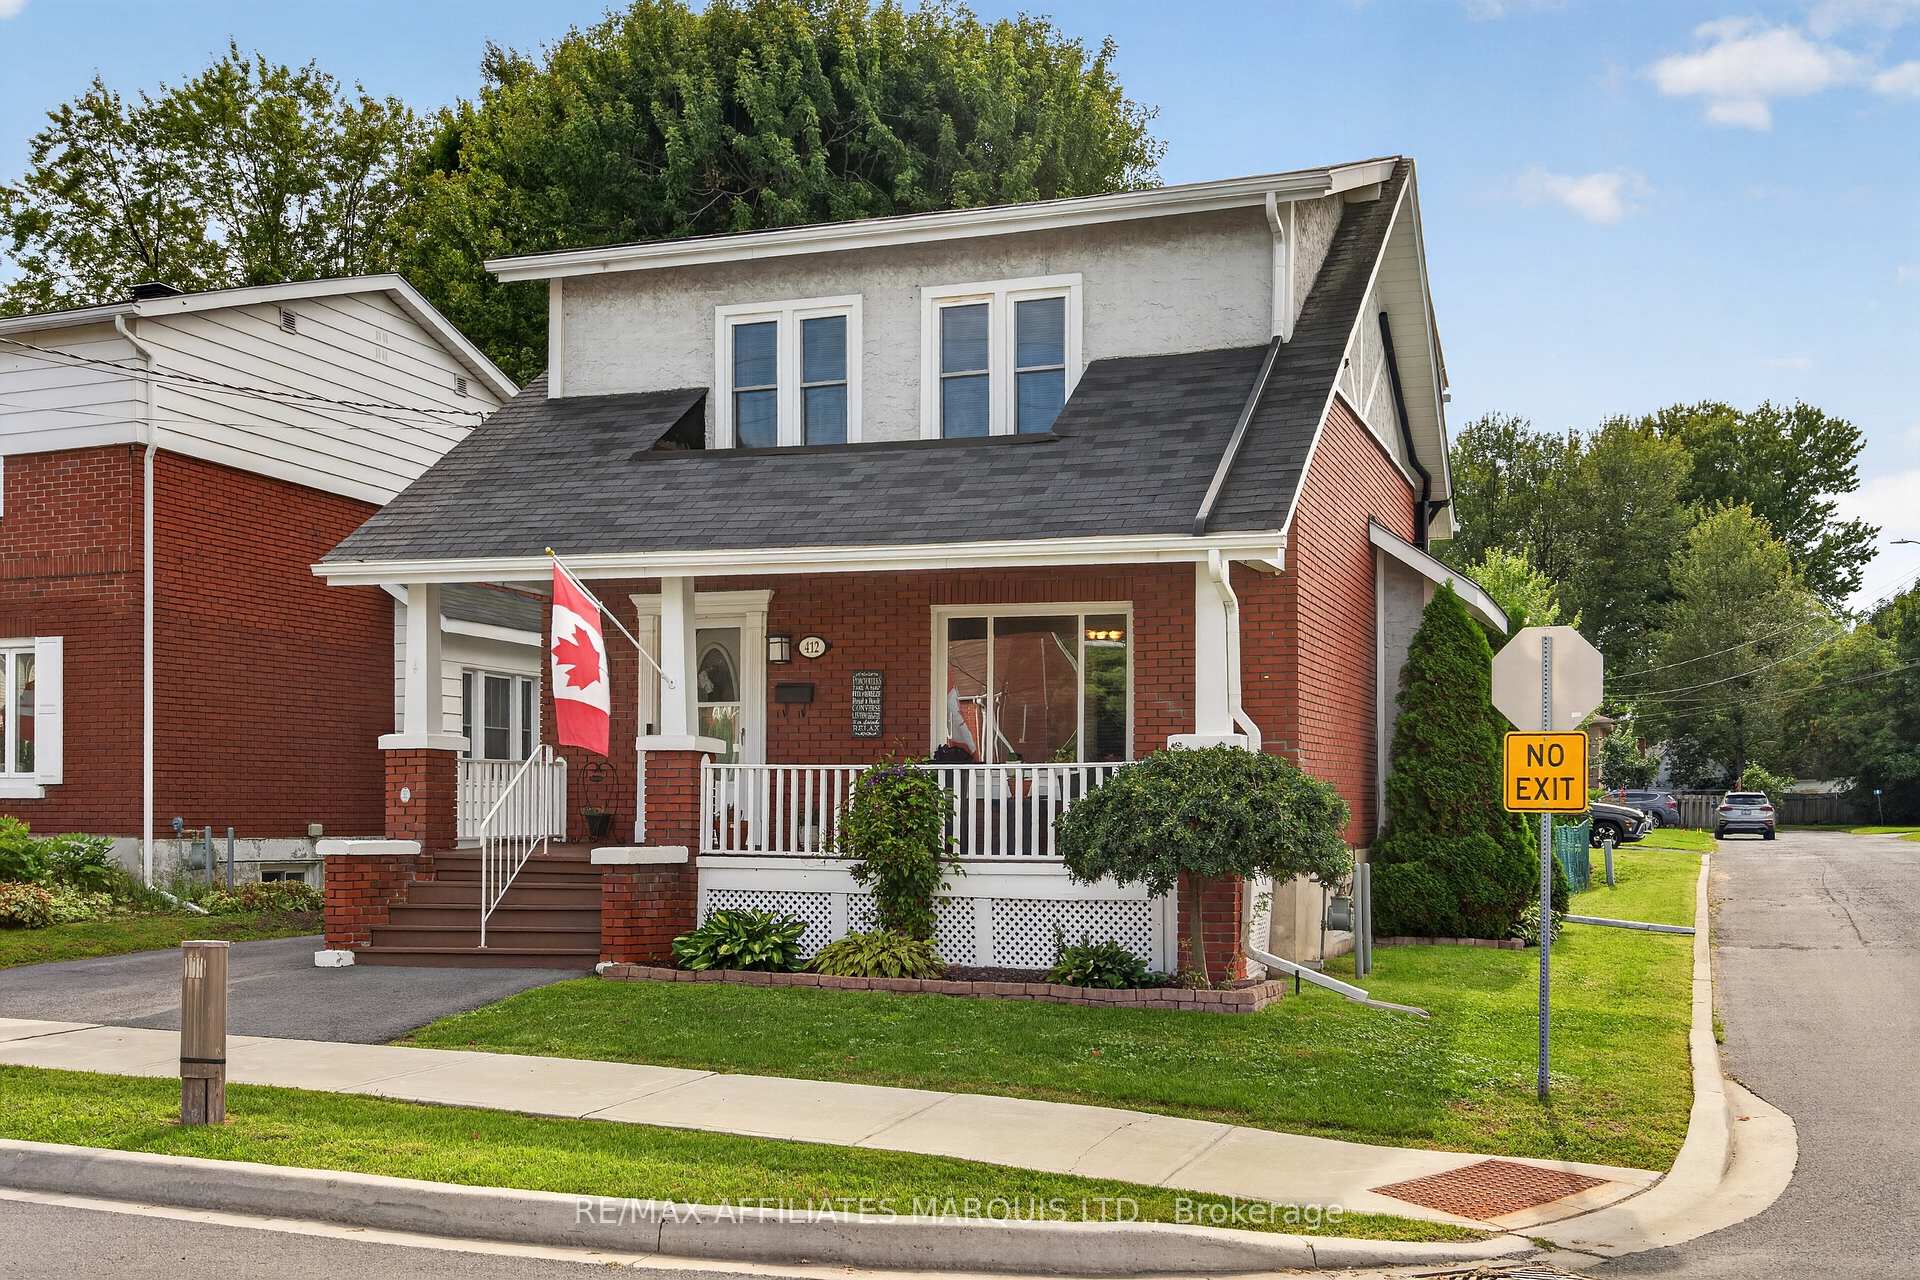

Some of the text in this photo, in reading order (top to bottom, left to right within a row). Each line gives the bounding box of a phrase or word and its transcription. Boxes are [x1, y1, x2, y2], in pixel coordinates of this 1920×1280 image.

[804, 641, 820, 653] 412
[1527, 743, 1564, 767] NO
[1516, 777, 1575, 800] EXIT
